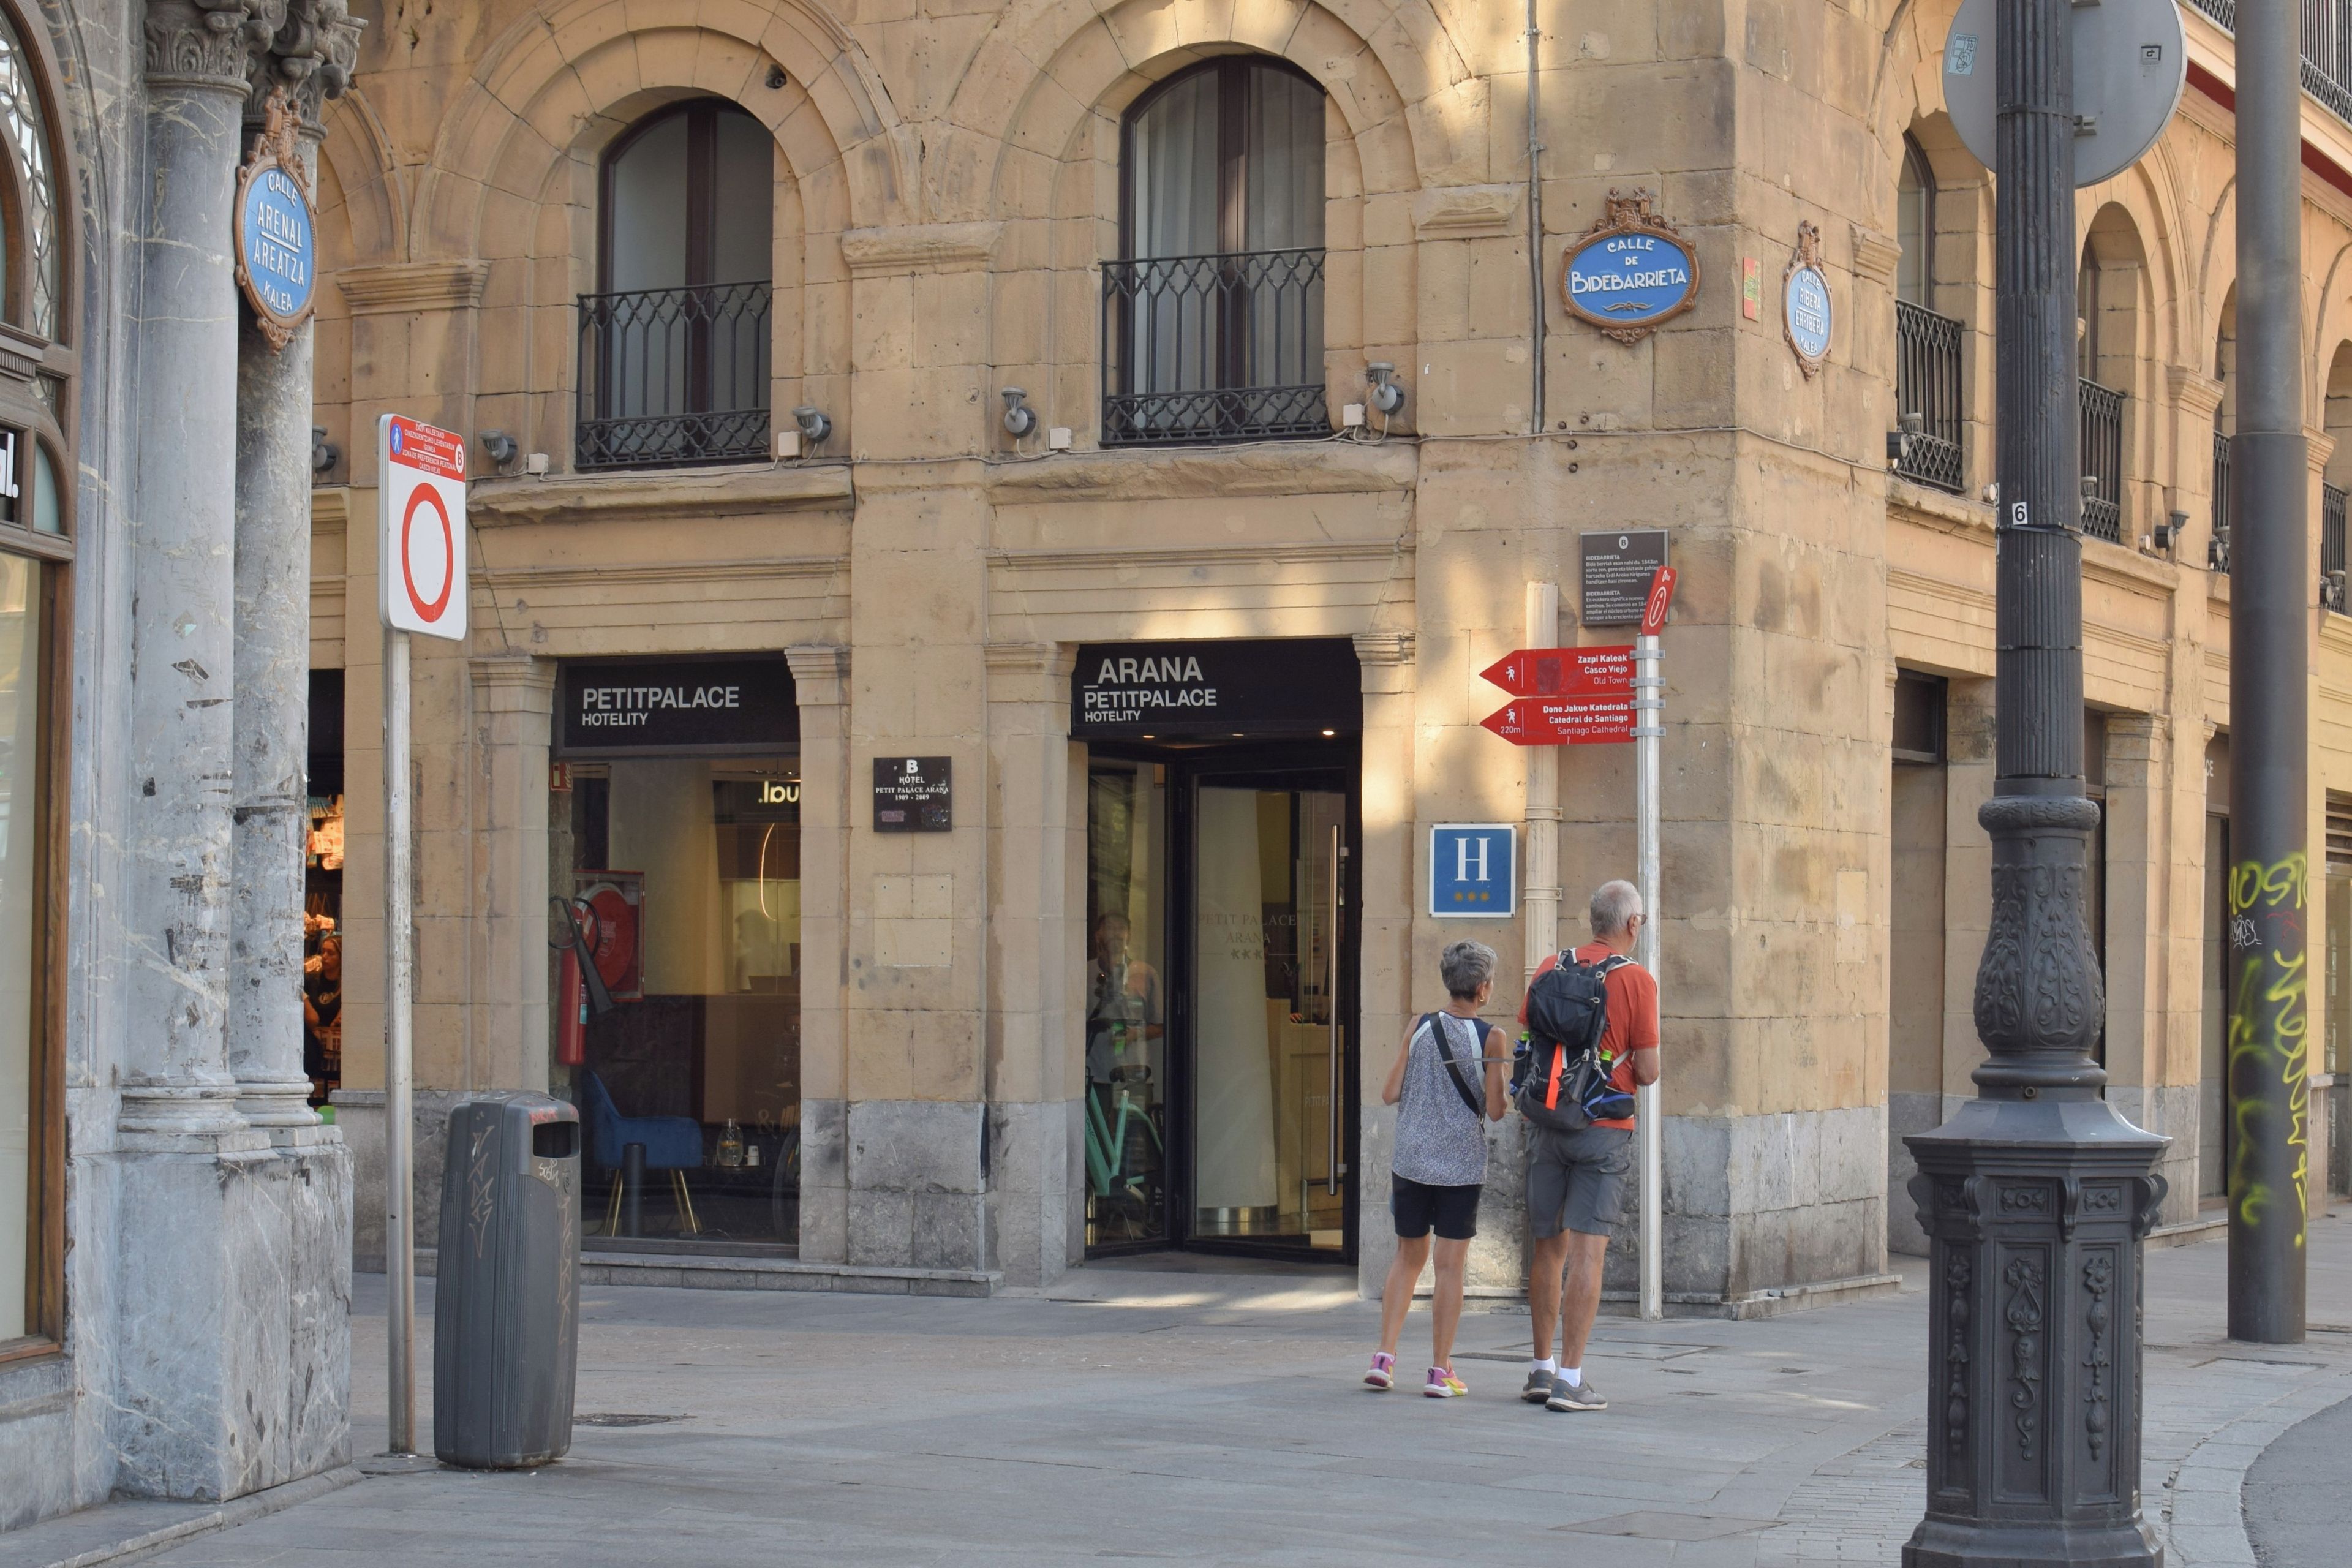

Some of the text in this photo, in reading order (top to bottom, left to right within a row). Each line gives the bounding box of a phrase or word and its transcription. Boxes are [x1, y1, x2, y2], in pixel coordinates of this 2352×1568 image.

[269, 173, 297, 207] CALLE
[258, 202, 302, 247] ARENAL
[1607, 238, 1655, 252] CALLE
[254, 238, 304, 287] AREATZA
[1625, 256, 1638, 265] DE
[1571, 268, 1687, 294] BIDEBARRIETA
[1801, 271, 1820, 290] CALLE
[263, 281, 292, 311] KALEA
[1799, 287, 1821, 312] RIBERA
[1795, 310, 1824, 336] ERRIBERA
[1800, 335, 1818, 353] KALEA
[417, 453, 440, 465] PREFERENCIA
[440, 459, 457, 472] PEATONAL
[458, 452, 462, 466] B
[419, 462, 431, 472] CASCO
[2015, 505, 2026, 522] 6
[1578, 654, 1627, 665] Zazpi Kaleak
[1584, 665, 1627, 674] Casco Viejo
[1594, 676, 1606, 685] Old
[582, 686, 740, 709] PETITPALACE
[1084, 688, 1218, 709] PETITPALACE
[1543, 704, 1562, 714] Done
[1589, 703, 1628, 711] Katedrala
[582, 712, 649, 726] HOTELITY
[1085, 710, 1141, 722] HOTELITY
[1549, 715, 1582, 724] Catedral
[1594, 714, 1628, 724] Santiago
[1557, 726, 1590, 736] Santiago
[907, 760, 918, 774] B
[1454, 837, 1491, 881] H
[1199, 914, 1297, 925] PETIT PALACE
[1226, 932, 1271, 944] ARANA
